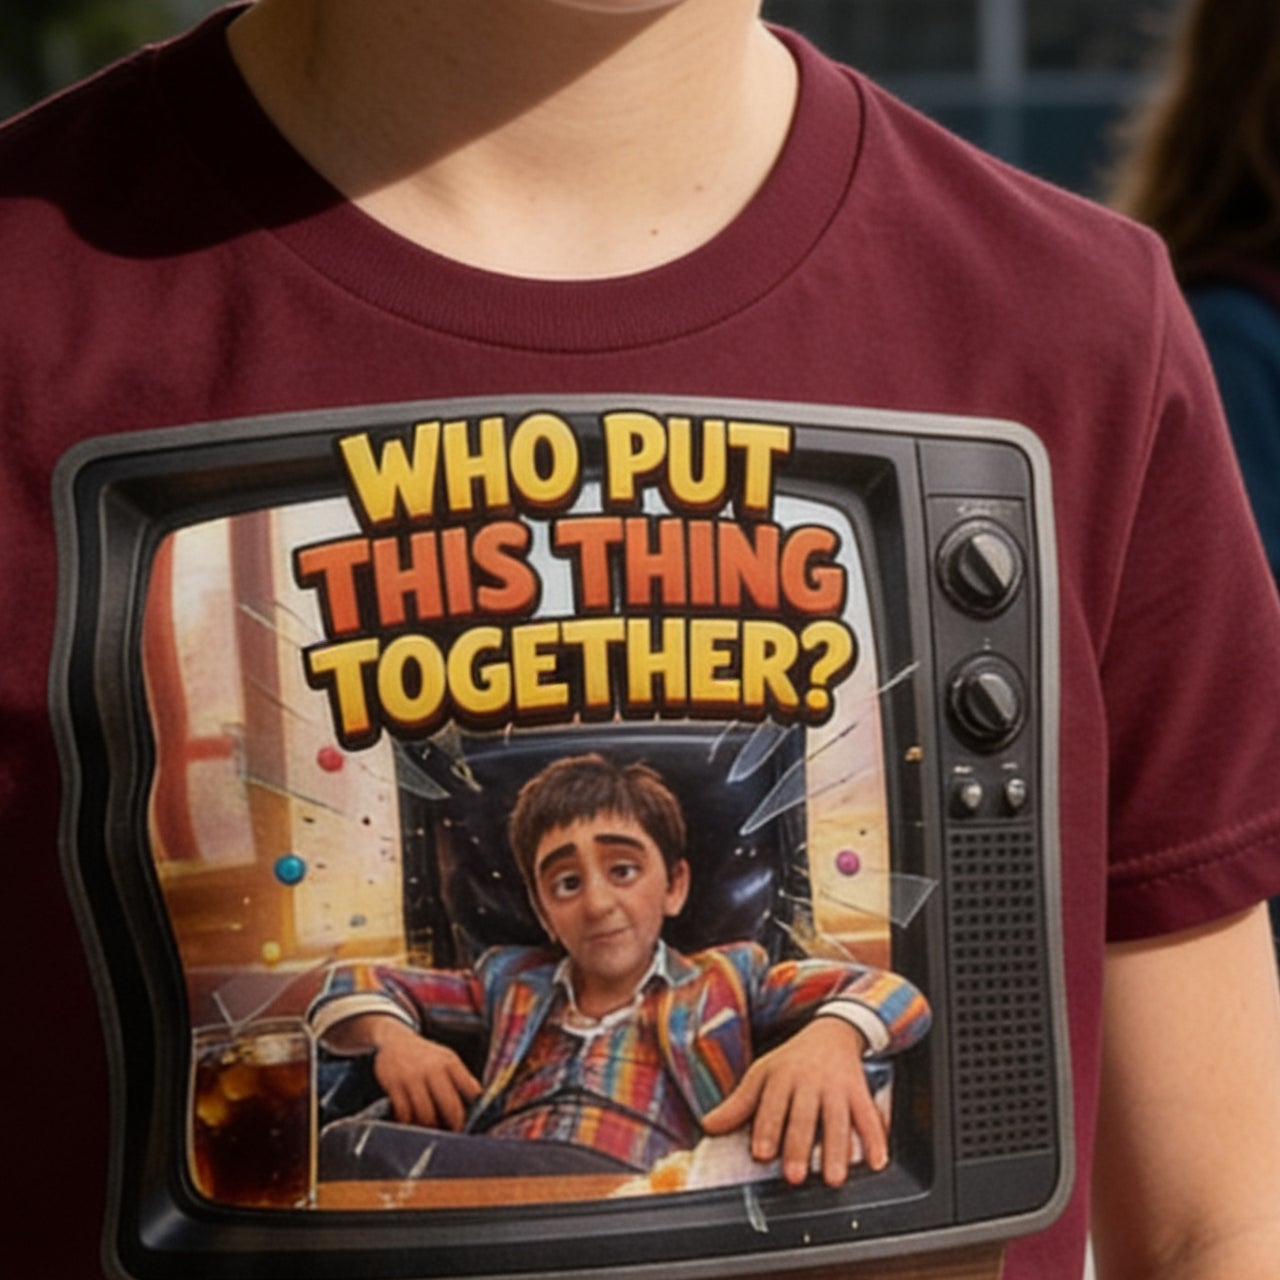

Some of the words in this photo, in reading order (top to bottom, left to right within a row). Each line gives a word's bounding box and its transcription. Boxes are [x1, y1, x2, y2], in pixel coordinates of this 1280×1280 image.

[339, 412, 579, 524] WHO
[603, 412, 791, 513] PUT
[297, 521, 537, 635] THIS
[554, 517, 845, 613] THING
[310, 618, 854, 737] TOGETHER?
